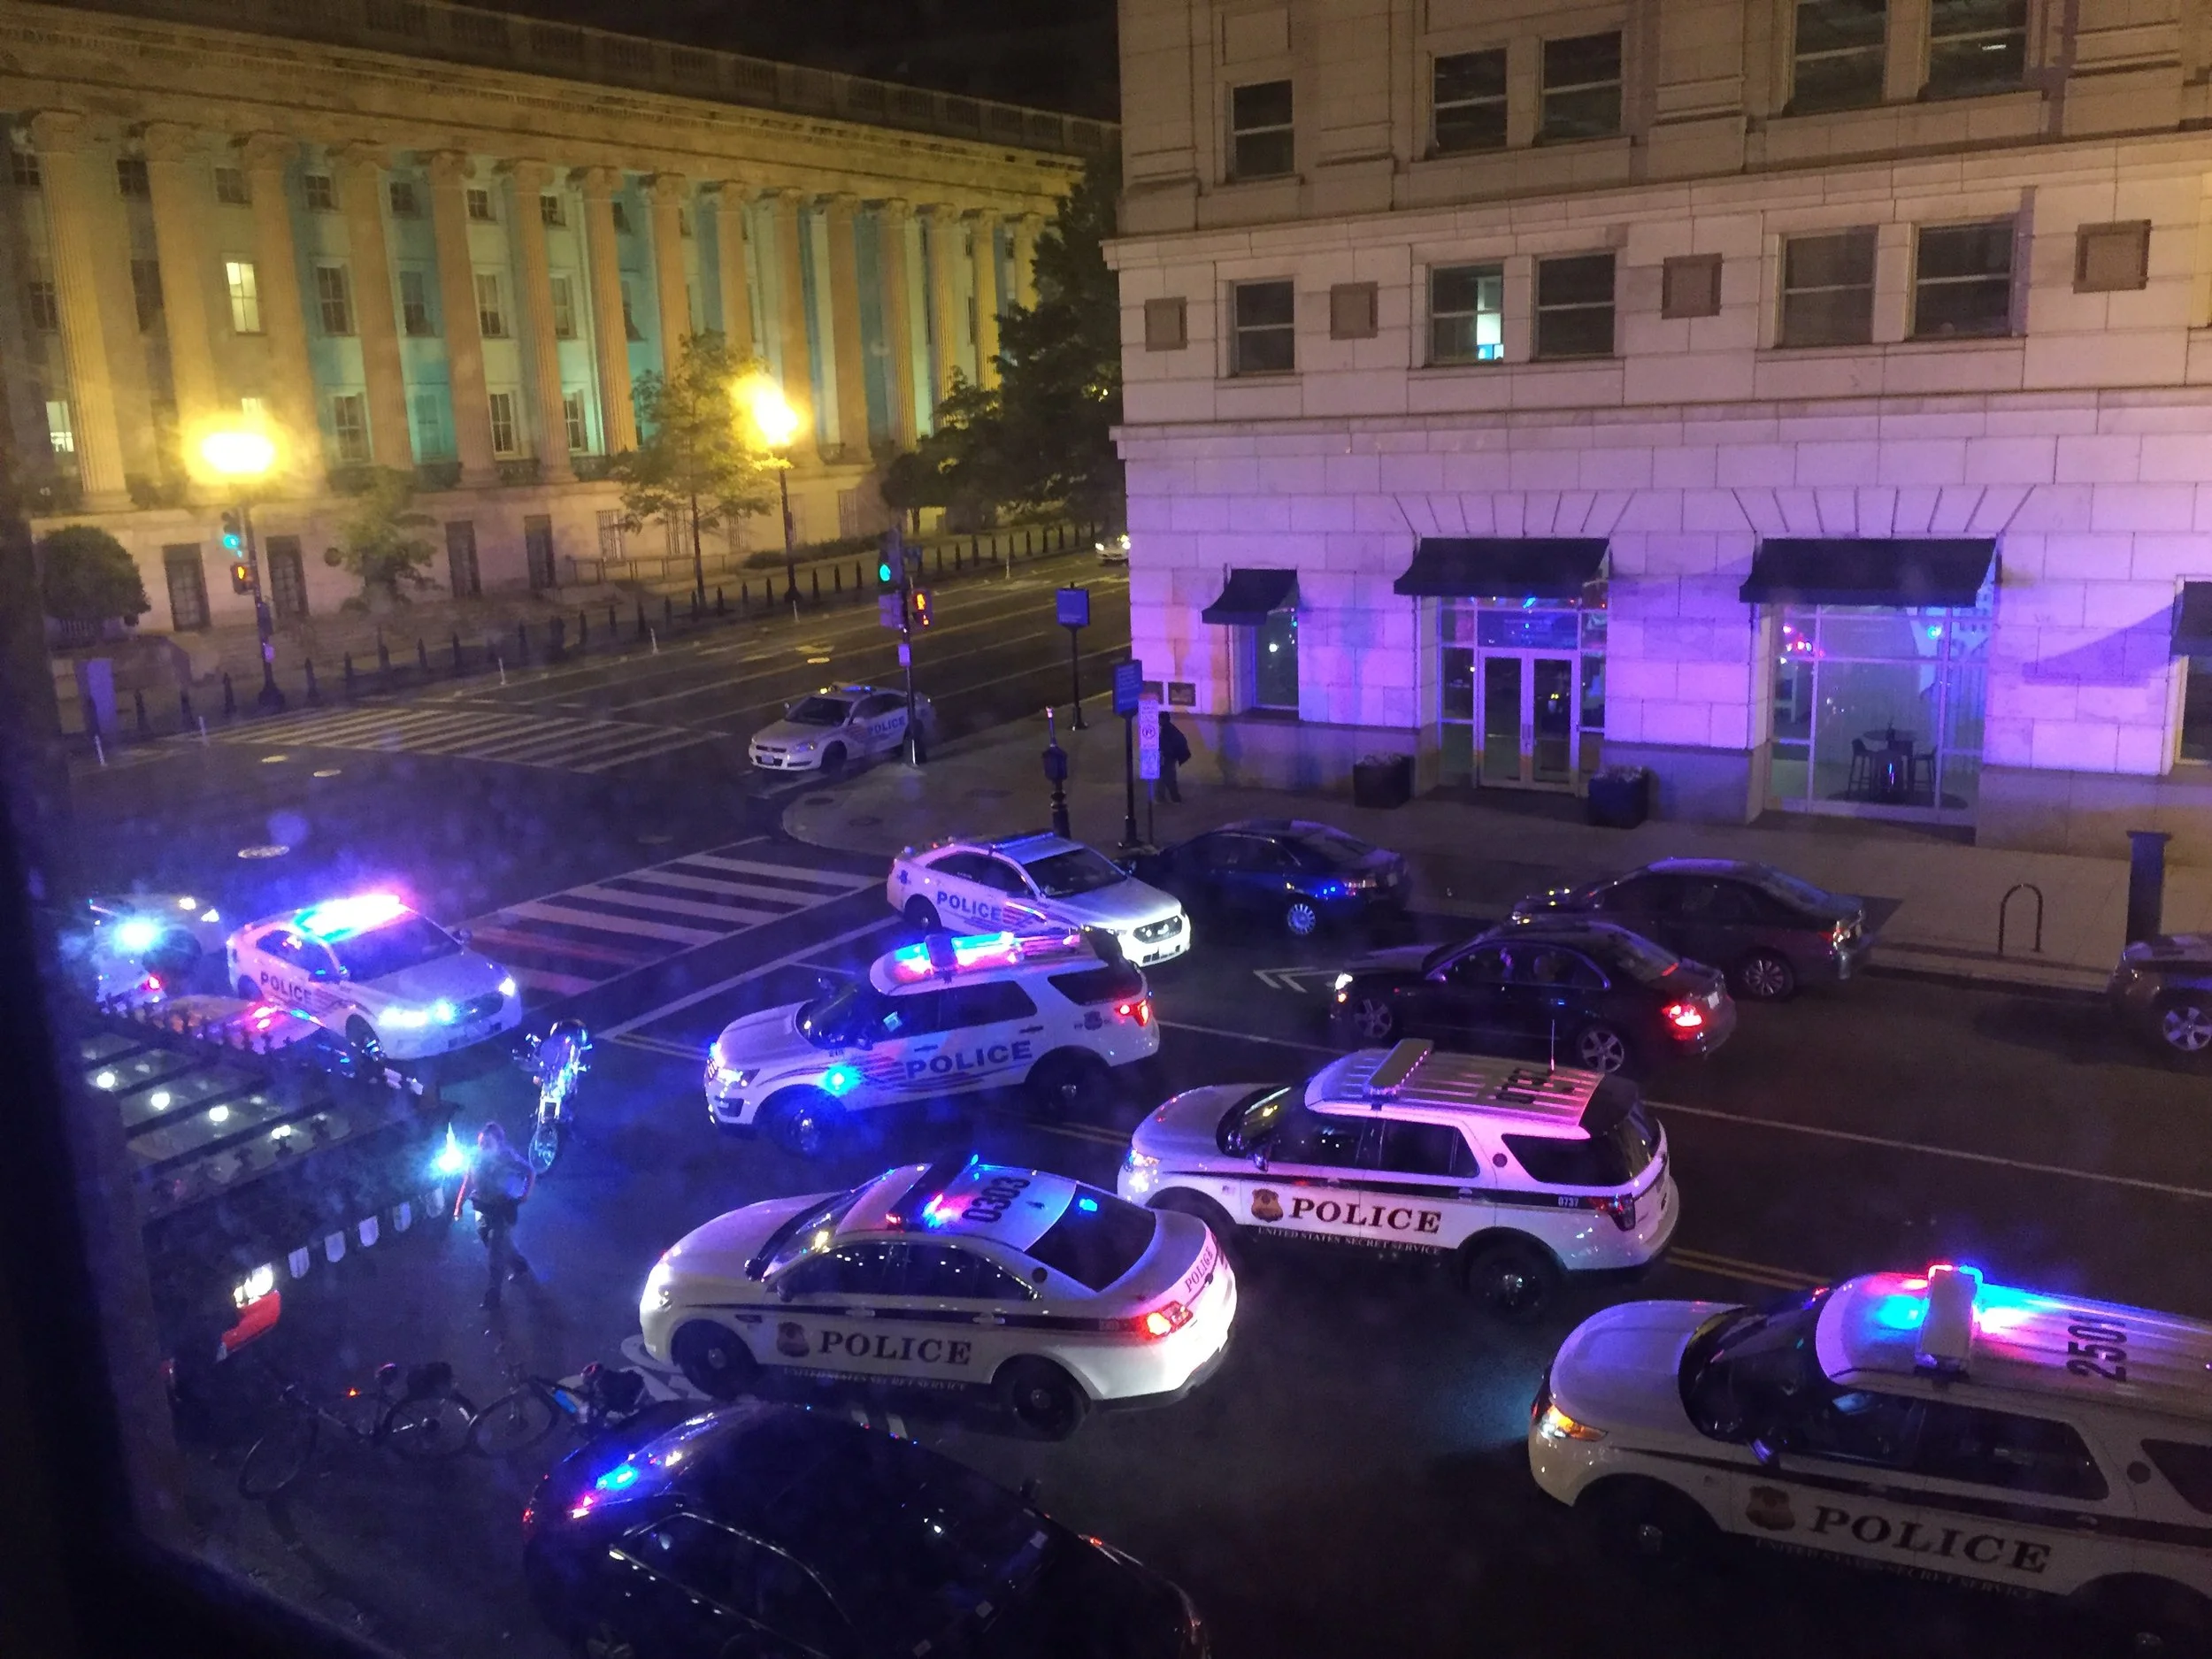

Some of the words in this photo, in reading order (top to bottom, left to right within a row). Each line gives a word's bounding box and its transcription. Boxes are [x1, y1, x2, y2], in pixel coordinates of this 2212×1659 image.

[868, 716, 906, 734] POLICE
[937, 891, 1002, 921] POLICE
[260, 971, 312, 1002] POLICE
[905, 1040, 1033, 1079] POLICE
[961, 1176, 1032, 1223] 0303
[1288, 1197, 1442, 1234] POLICE
[1257, 1226, 1298, 1239] UNITED
[1301, 1231, 1340, 1244] STATES
[1344, 1236, 1389, 1249] SECRET
[1392, 1241, 1440, 1256] SERVICE
[1185, 1246, 1213, 1293] POLICE
[818, 1330, 972, 1365] POLICE
[2066, 1313, 2127, 1381] 2501
[1809, 1505, 2052, 1573] POLICE
